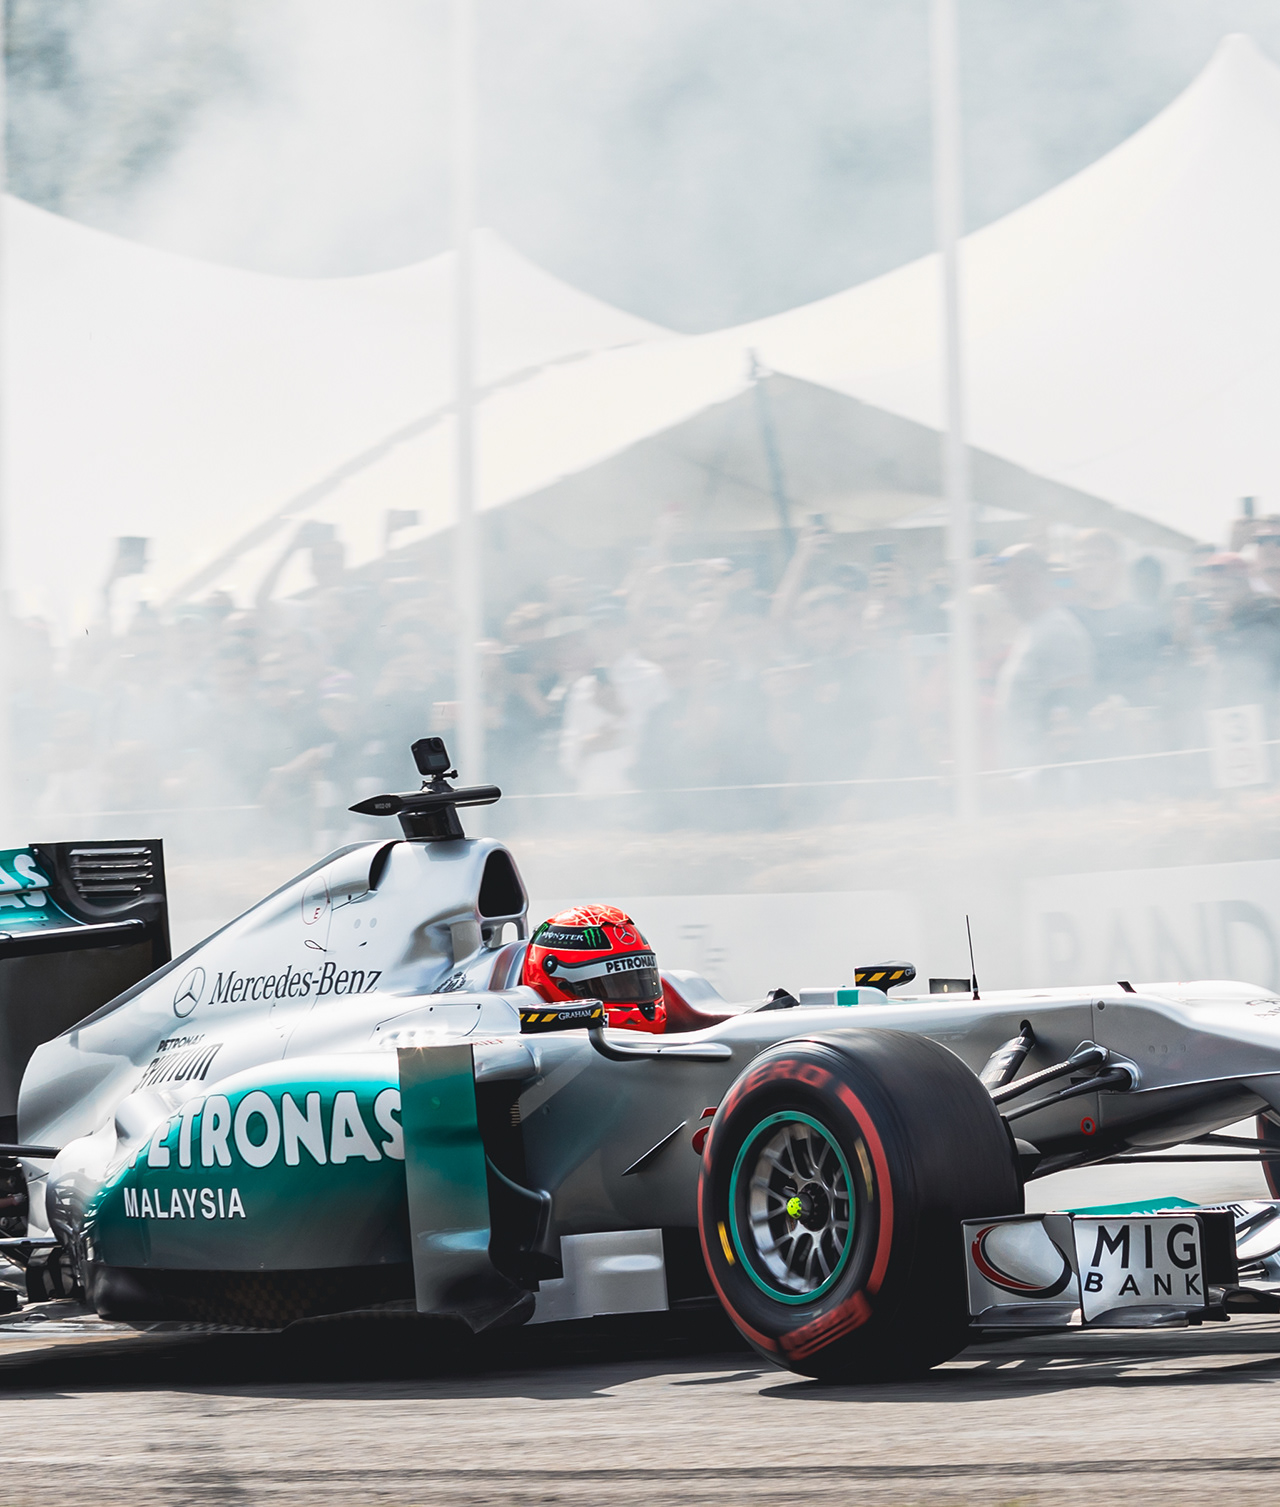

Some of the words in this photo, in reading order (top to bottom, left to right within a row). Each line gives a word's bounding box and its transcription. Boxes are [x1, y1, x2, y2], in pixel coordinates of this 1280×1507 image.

[606, 956, 656, 973] PETRONAS
[208, 961, 382, 1006] Mercedes-Benz
[558, 1009, 592, 1020] GRAHAM
[156, 1033, 206, 1053] PETRONAS
[128, 1088, 406, 1170] ETRONAS
[123, 1187, 247, 1220] MALAYSIA
[1090, 1223, 1198, 1270] MIG
[1083, 1271, 1203, 1296] BANK
